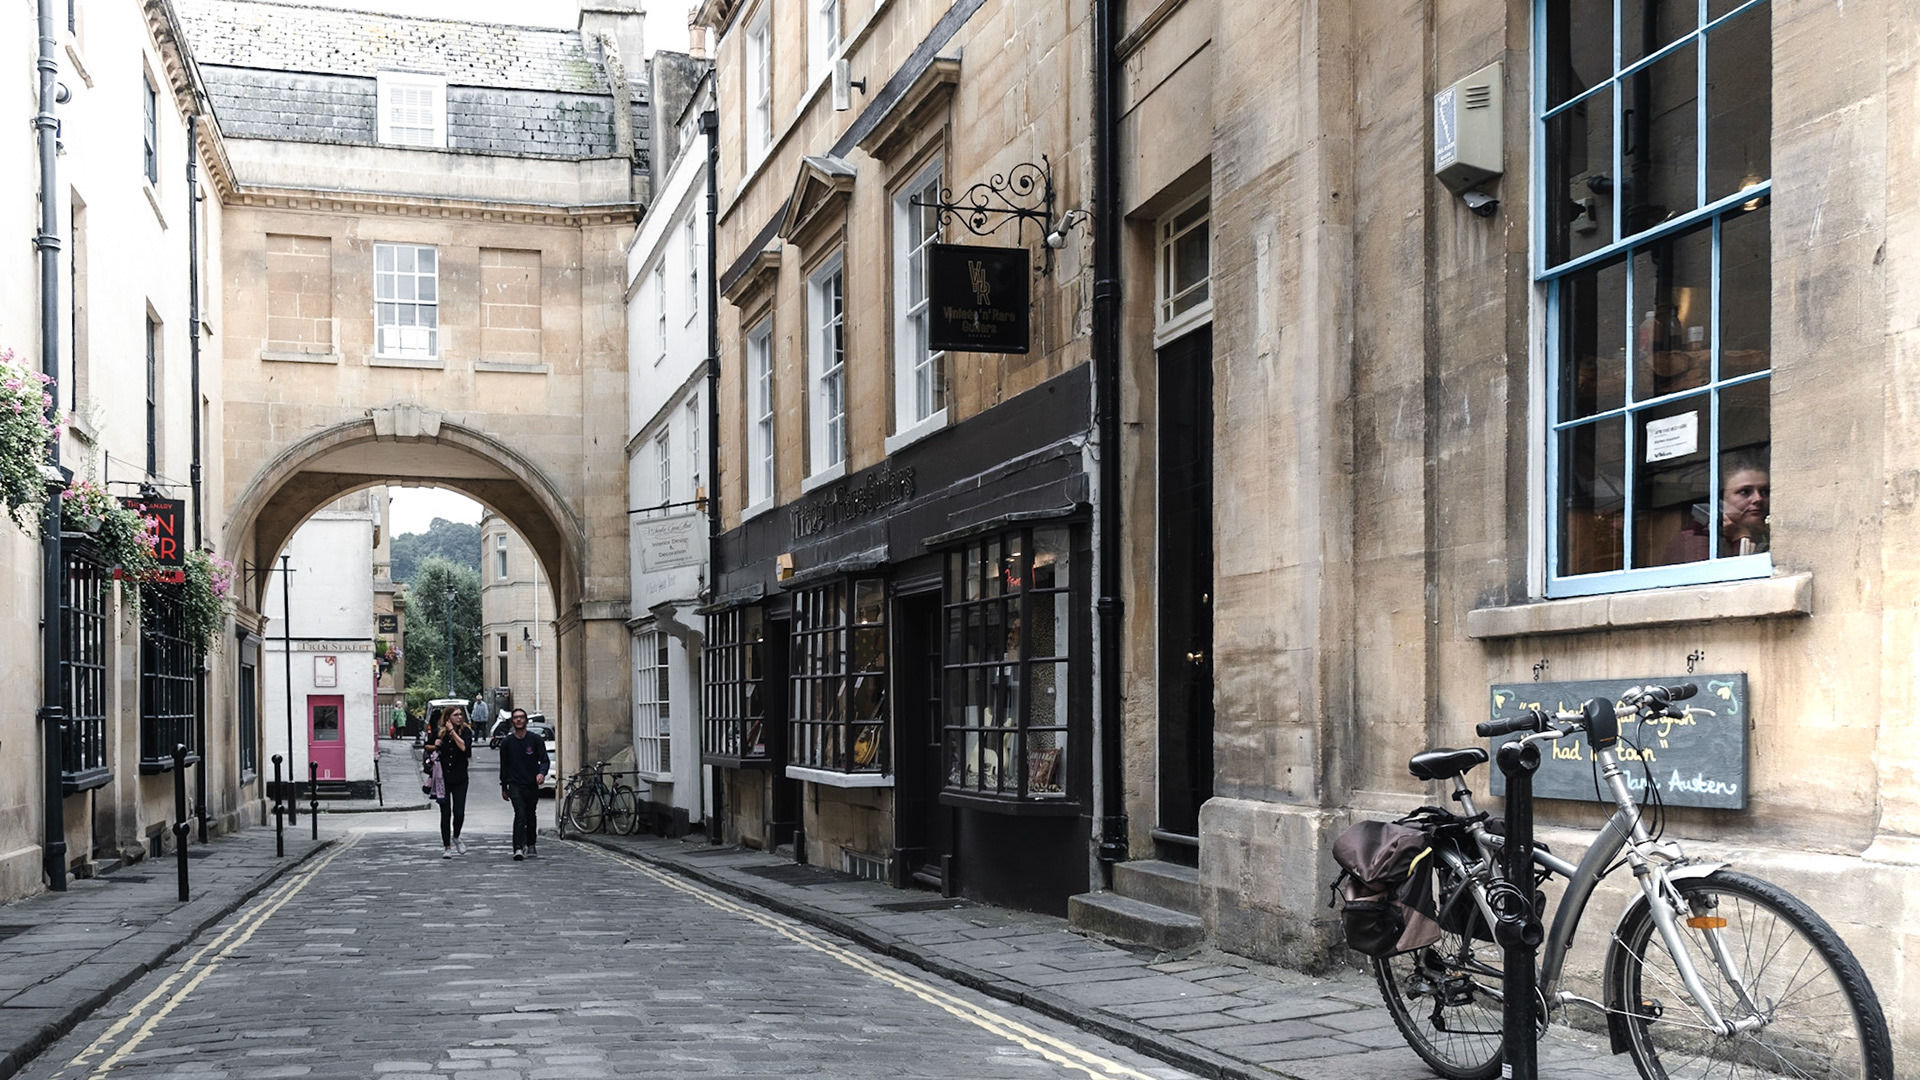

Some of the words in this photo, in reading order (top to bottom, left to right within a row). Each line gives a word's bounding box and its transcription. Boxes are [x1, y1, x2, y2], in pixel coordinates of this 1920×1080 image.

[993, 308, 1016, 322] Rare
[301, 642, 328, 651] TRIM
[330, 642, 371, 652] STREET
[1552, 738, 1583, 761] had
[1667, 768, 1738, 795] Austen
